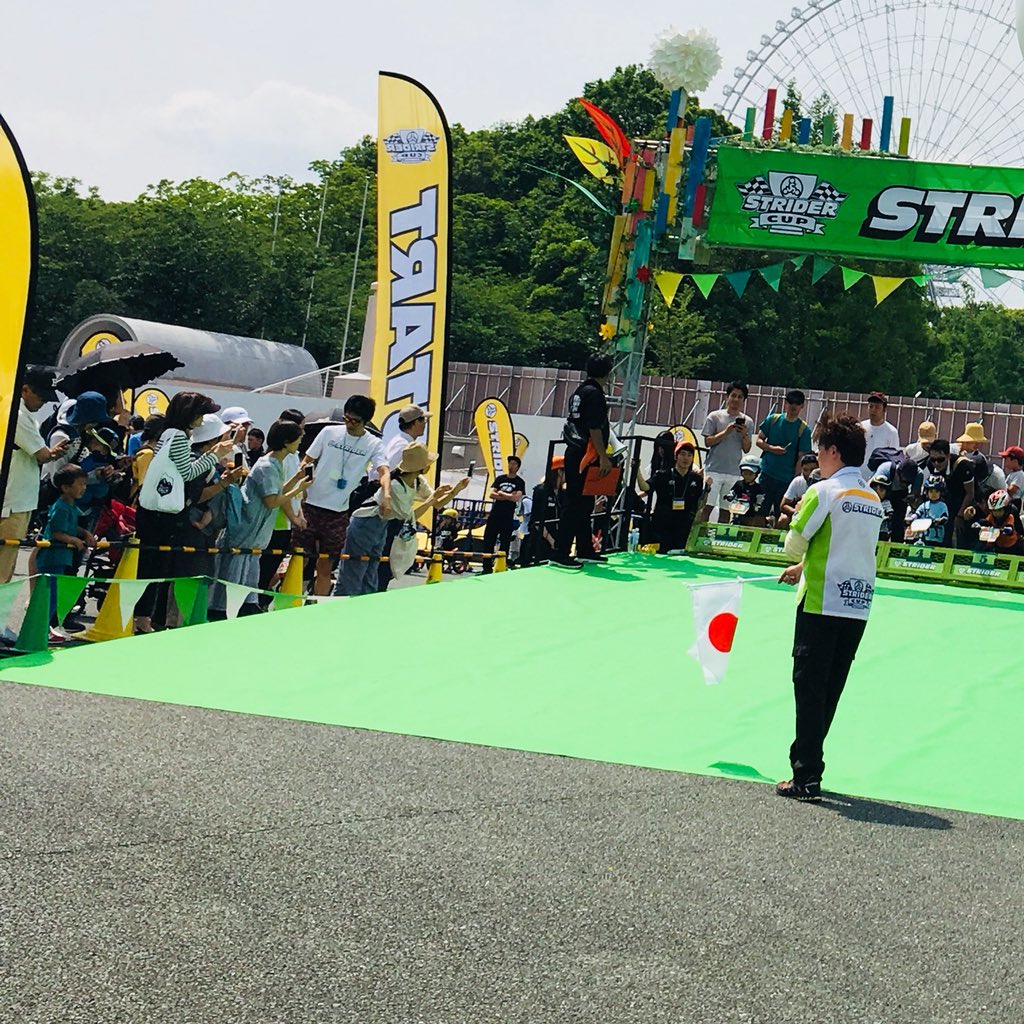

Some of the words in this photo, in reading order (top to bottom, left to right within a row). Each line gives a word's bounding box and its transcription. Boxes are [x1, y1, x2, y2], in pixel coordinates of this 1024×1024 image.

[742, 195, 839, 217] STRIDER
[767, 215, 808, 225] CUP
[902, 562, 936, 570] STRIDER
[966, 568, 1001, 576] STRIDER
